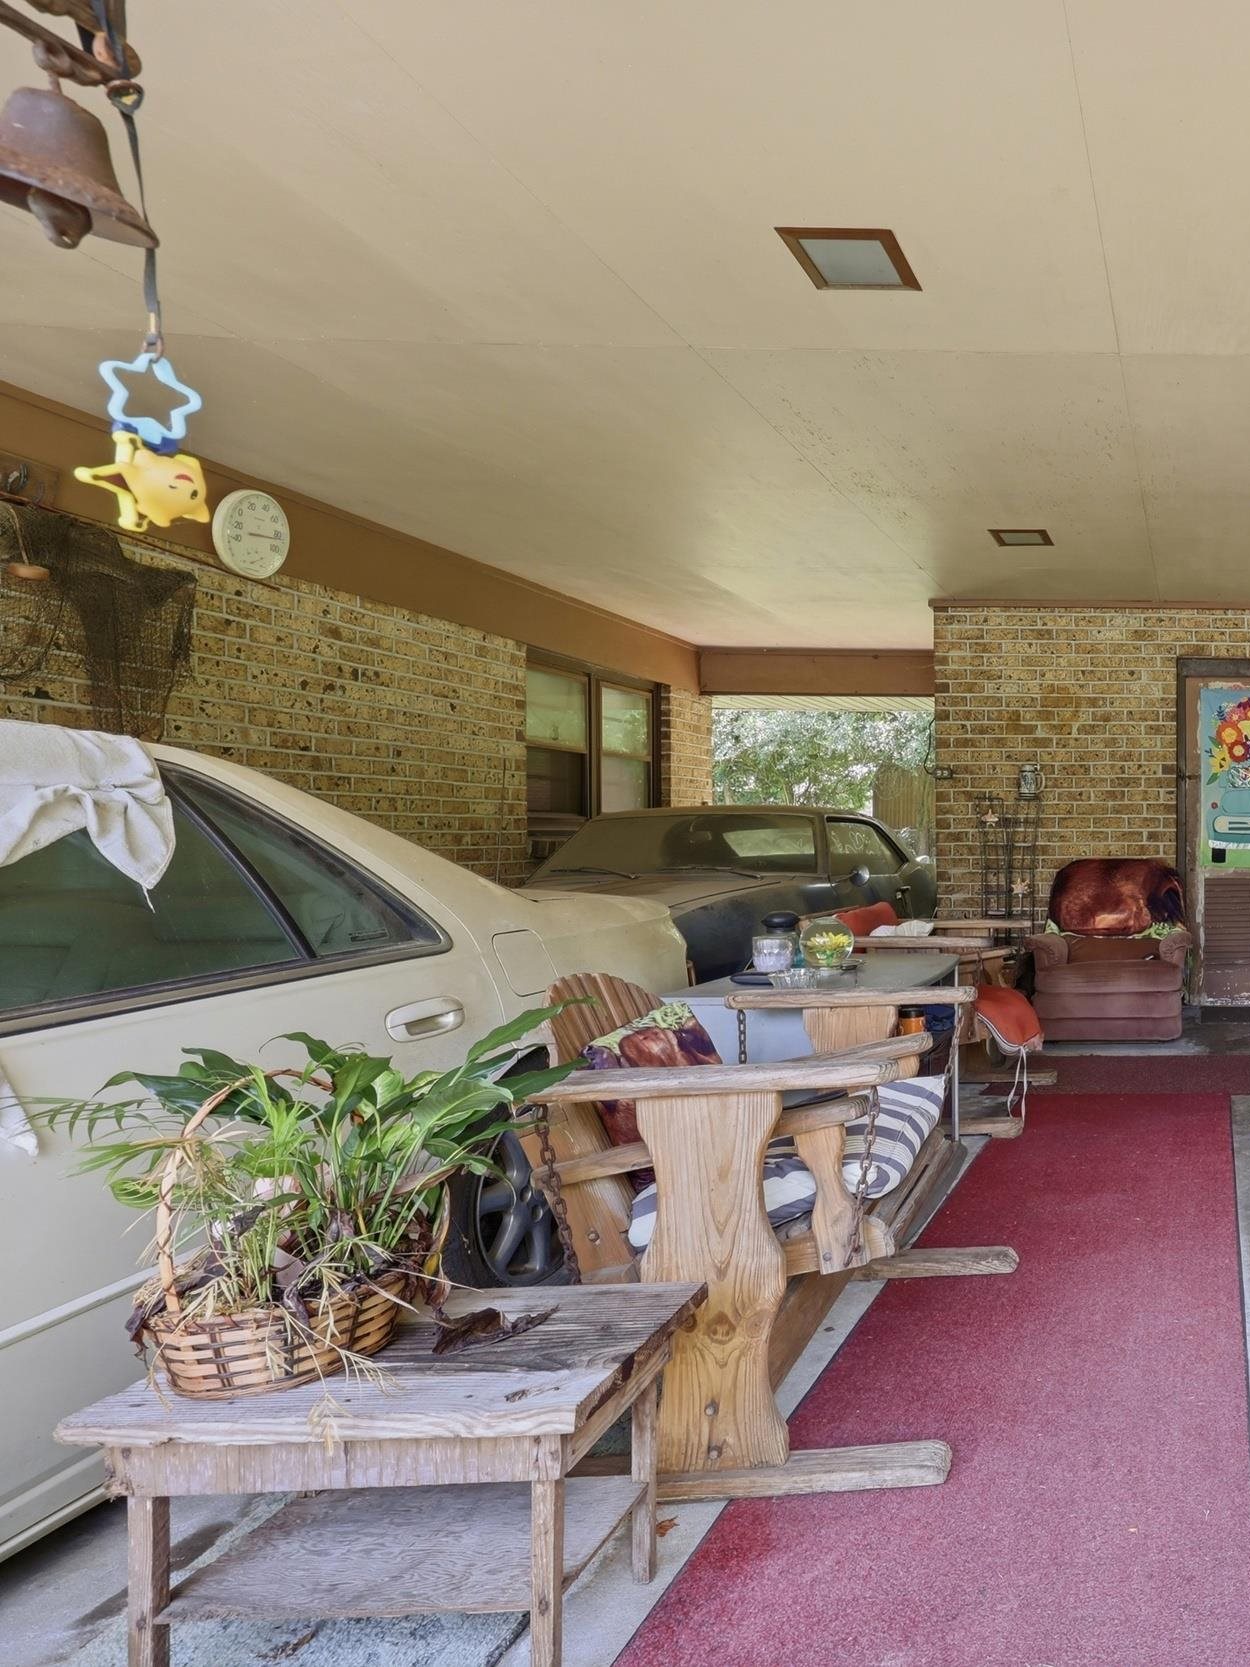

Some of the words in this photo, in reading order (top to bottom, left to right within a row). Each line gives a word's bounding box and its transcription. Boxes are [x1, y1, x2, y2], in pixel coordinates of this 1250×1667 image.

[247, 502, 256, 511] 20
[261, 504, 270, 512] 40
[238, 508, 243, 516] 0
[271, 515, 279, 523] 60
[273, 530, 282, 539] 80
[269, 544, 279, 553] 100
